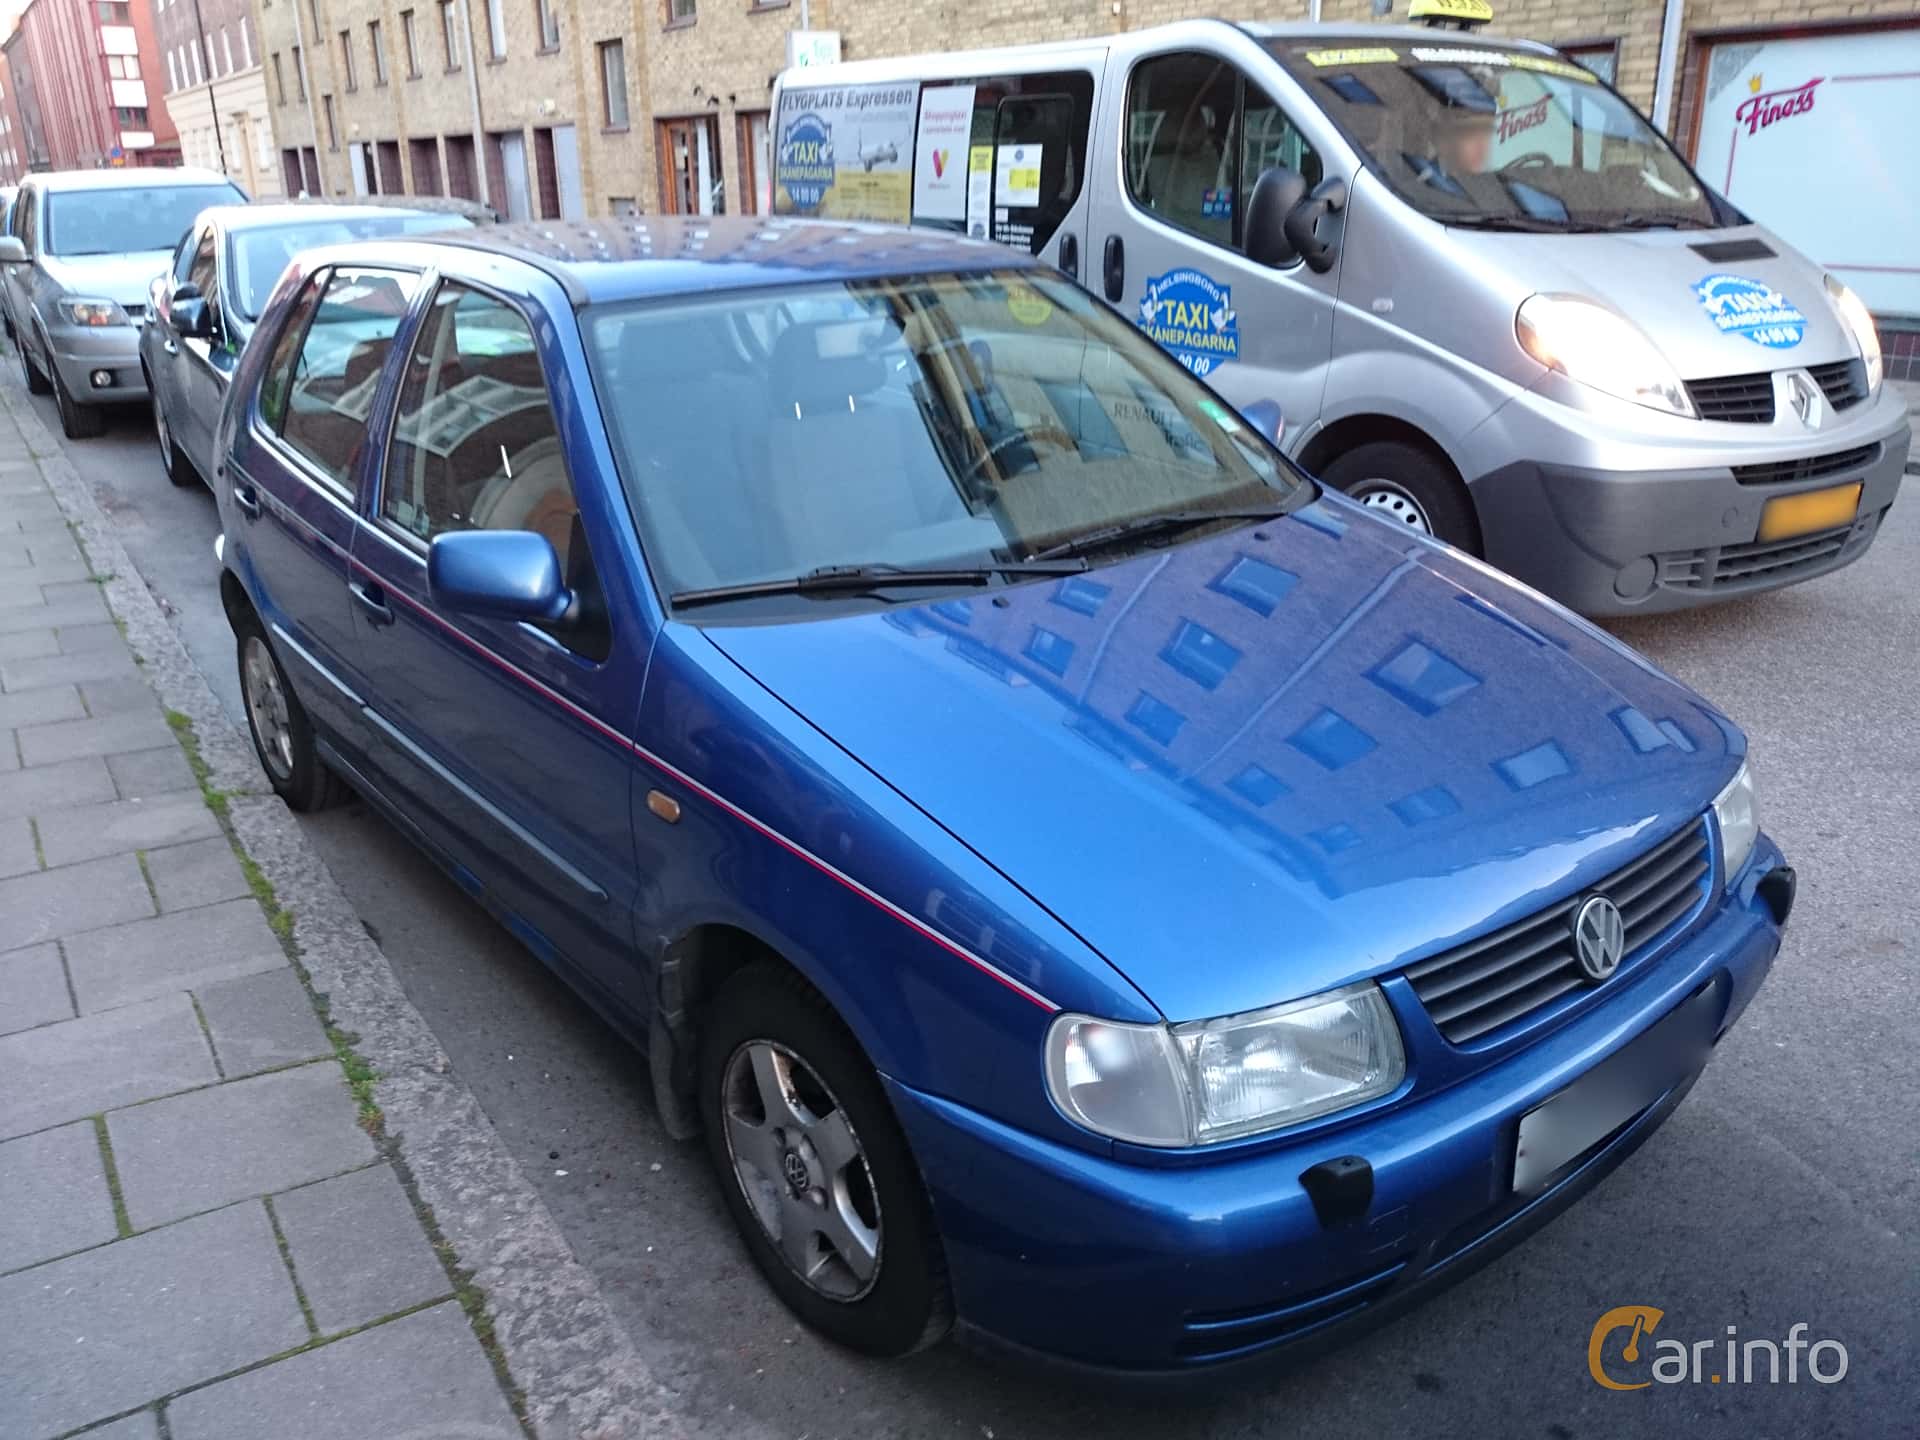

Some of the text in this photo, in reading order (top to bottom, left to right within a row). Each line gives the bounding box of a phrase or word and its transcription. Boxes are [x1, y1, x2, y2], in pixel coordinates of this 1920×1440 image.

[782, 88, 912, 112] FLYGPLATS Expressen
[793, 142, 819, 165] TAXI
[1157, 271, 1221, 302] HELSINGBORG
[1164, 299, 1209, 331] TAXI
[1194, 356, 1210, 375] 00
[1114, 402, 1173, 427] RENAULT
